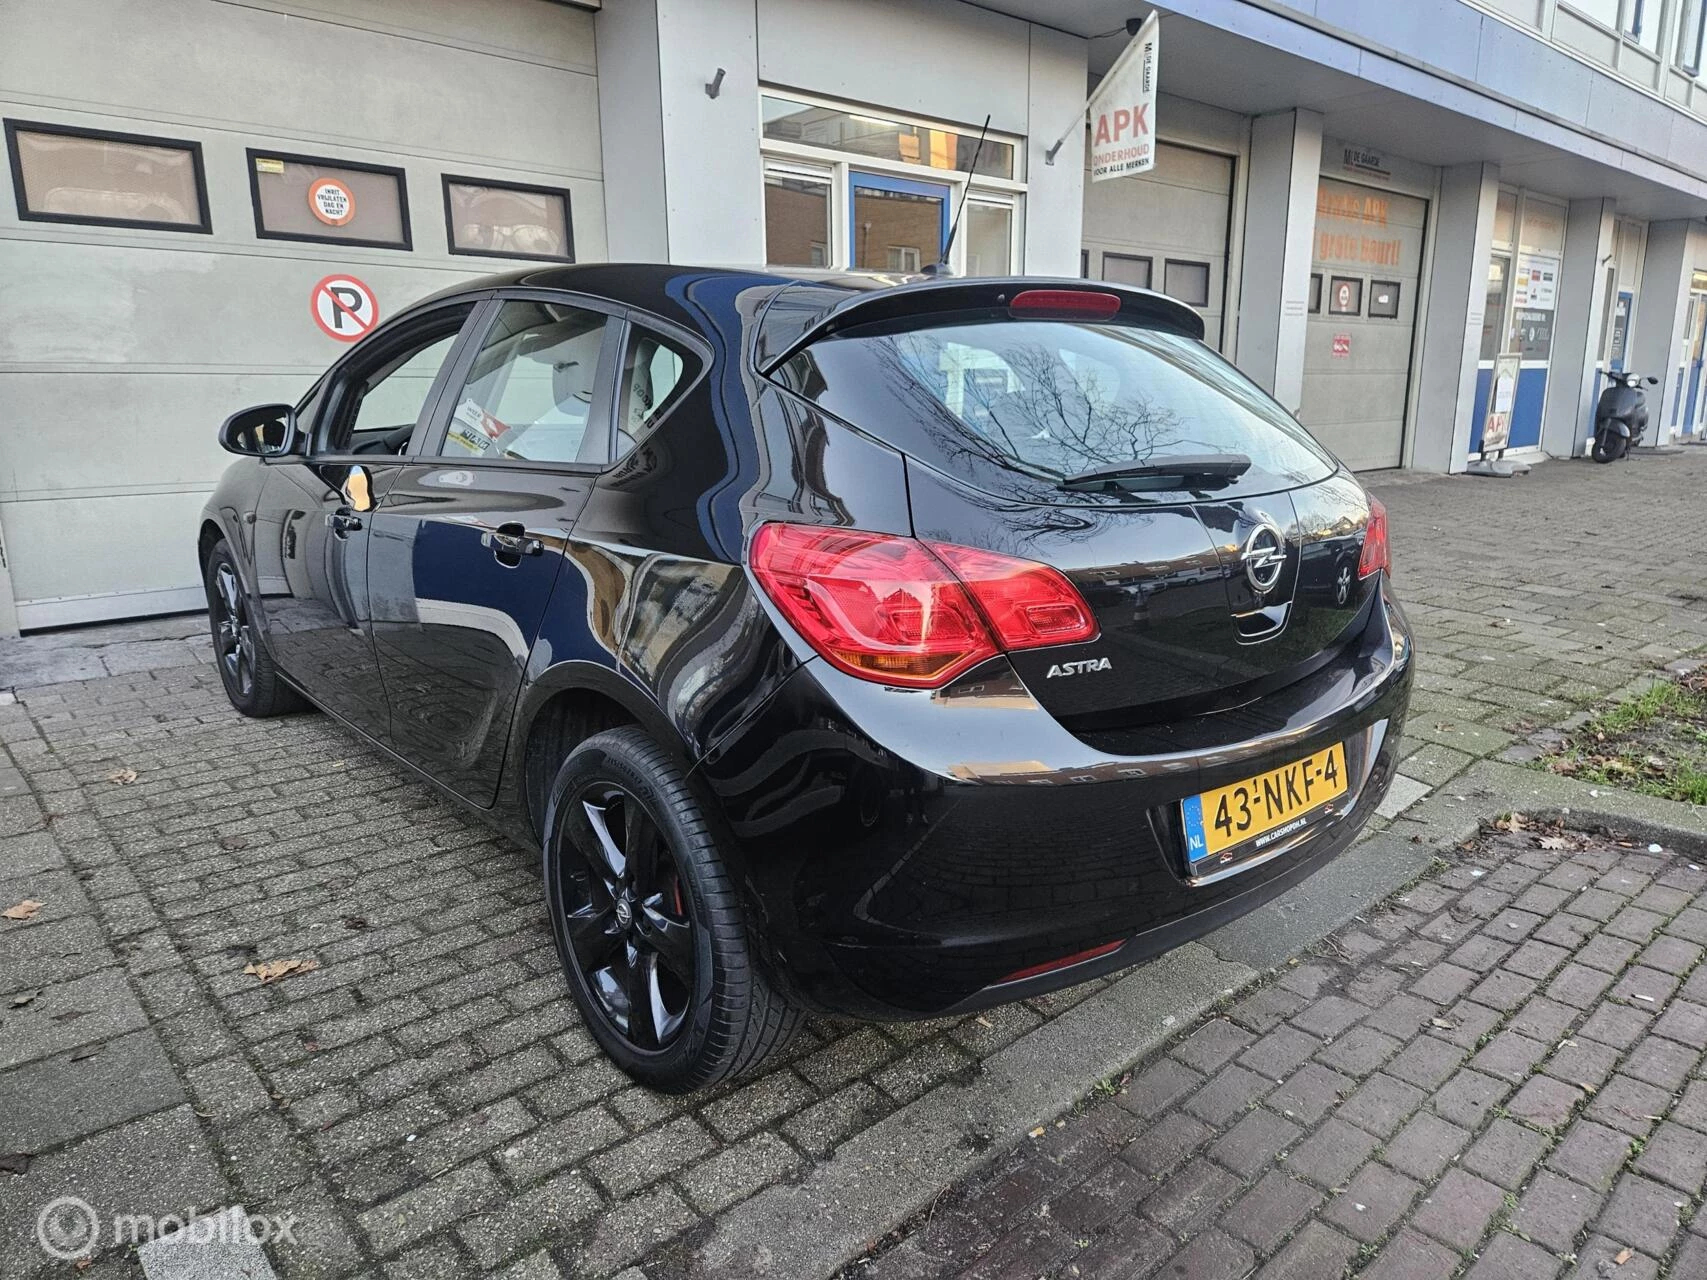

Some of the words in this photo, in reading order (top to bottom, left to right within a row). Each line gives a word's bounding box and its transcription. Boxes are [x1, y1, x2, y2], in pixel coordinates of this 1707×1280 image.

[1094, 102, 1149, 147] APK
[1093, 144, 1150, 166] ONDERHOUD
[1109, 163, 1124, 173] ALLE
[1126, 157, 1150, 169] MERKEN
[317, 194, 347, 203] VRIJLATEN
[325, 208, 343, 216] NACHT
[1046, 657, 1112, 679] ASTRA
[1214, 749, 1338, 838] 43-NKF-4
[1190, 833, 1204, 851] NL
